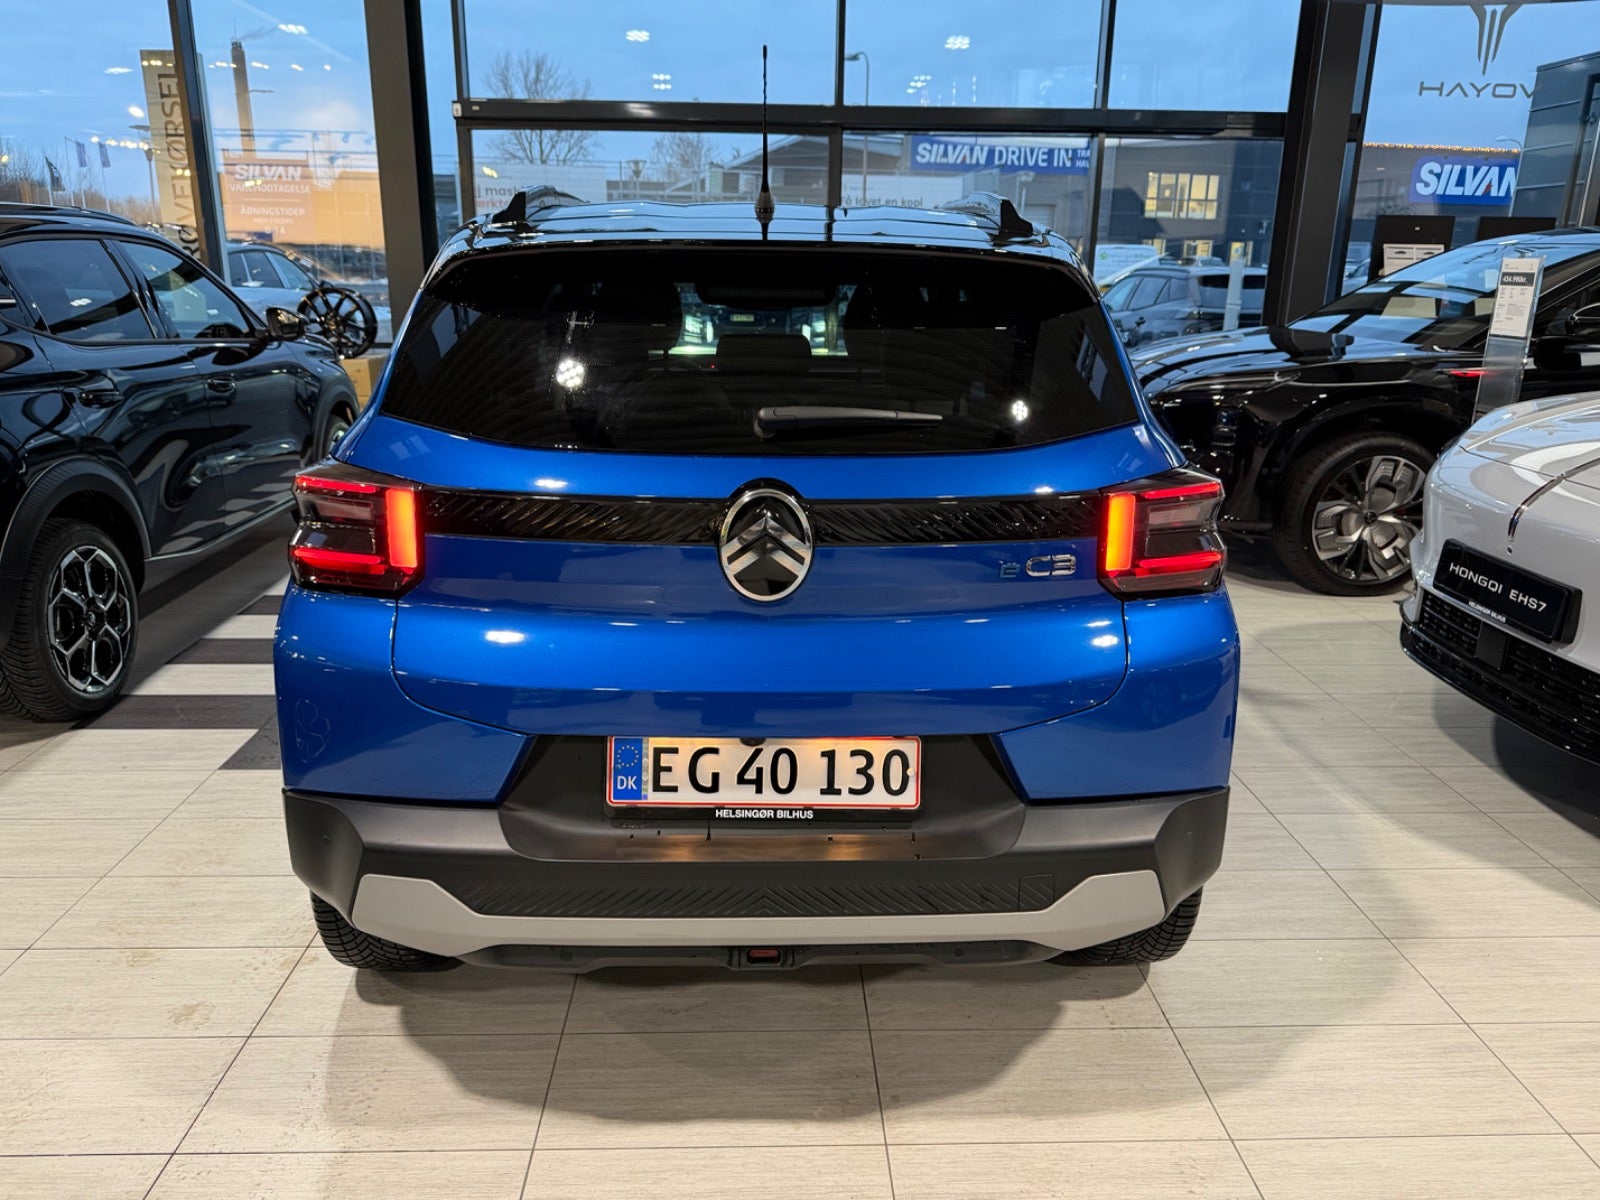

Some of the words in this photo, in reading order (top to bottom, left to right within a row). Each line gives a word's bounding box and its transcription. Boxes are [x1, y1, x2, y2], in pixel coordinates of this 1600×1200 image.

[915, 142, 987, 166] SILVAN
[994, 147, 1048, 167] DRIVE
[1053, 149, 1073, 168] IN
[235, 164, 302, 181] SILVAN
[1509, 588, 1547, 613] EHS7
[652, 746, 720, 793] EG
[736, 747, 798, 795] 40
[819, 749, 911, 796] 130
[616, 776, 638, 790] DK
[715, 809, 774, 819] HELSINGØR
[776, 810, 814, 819] BILHUS
